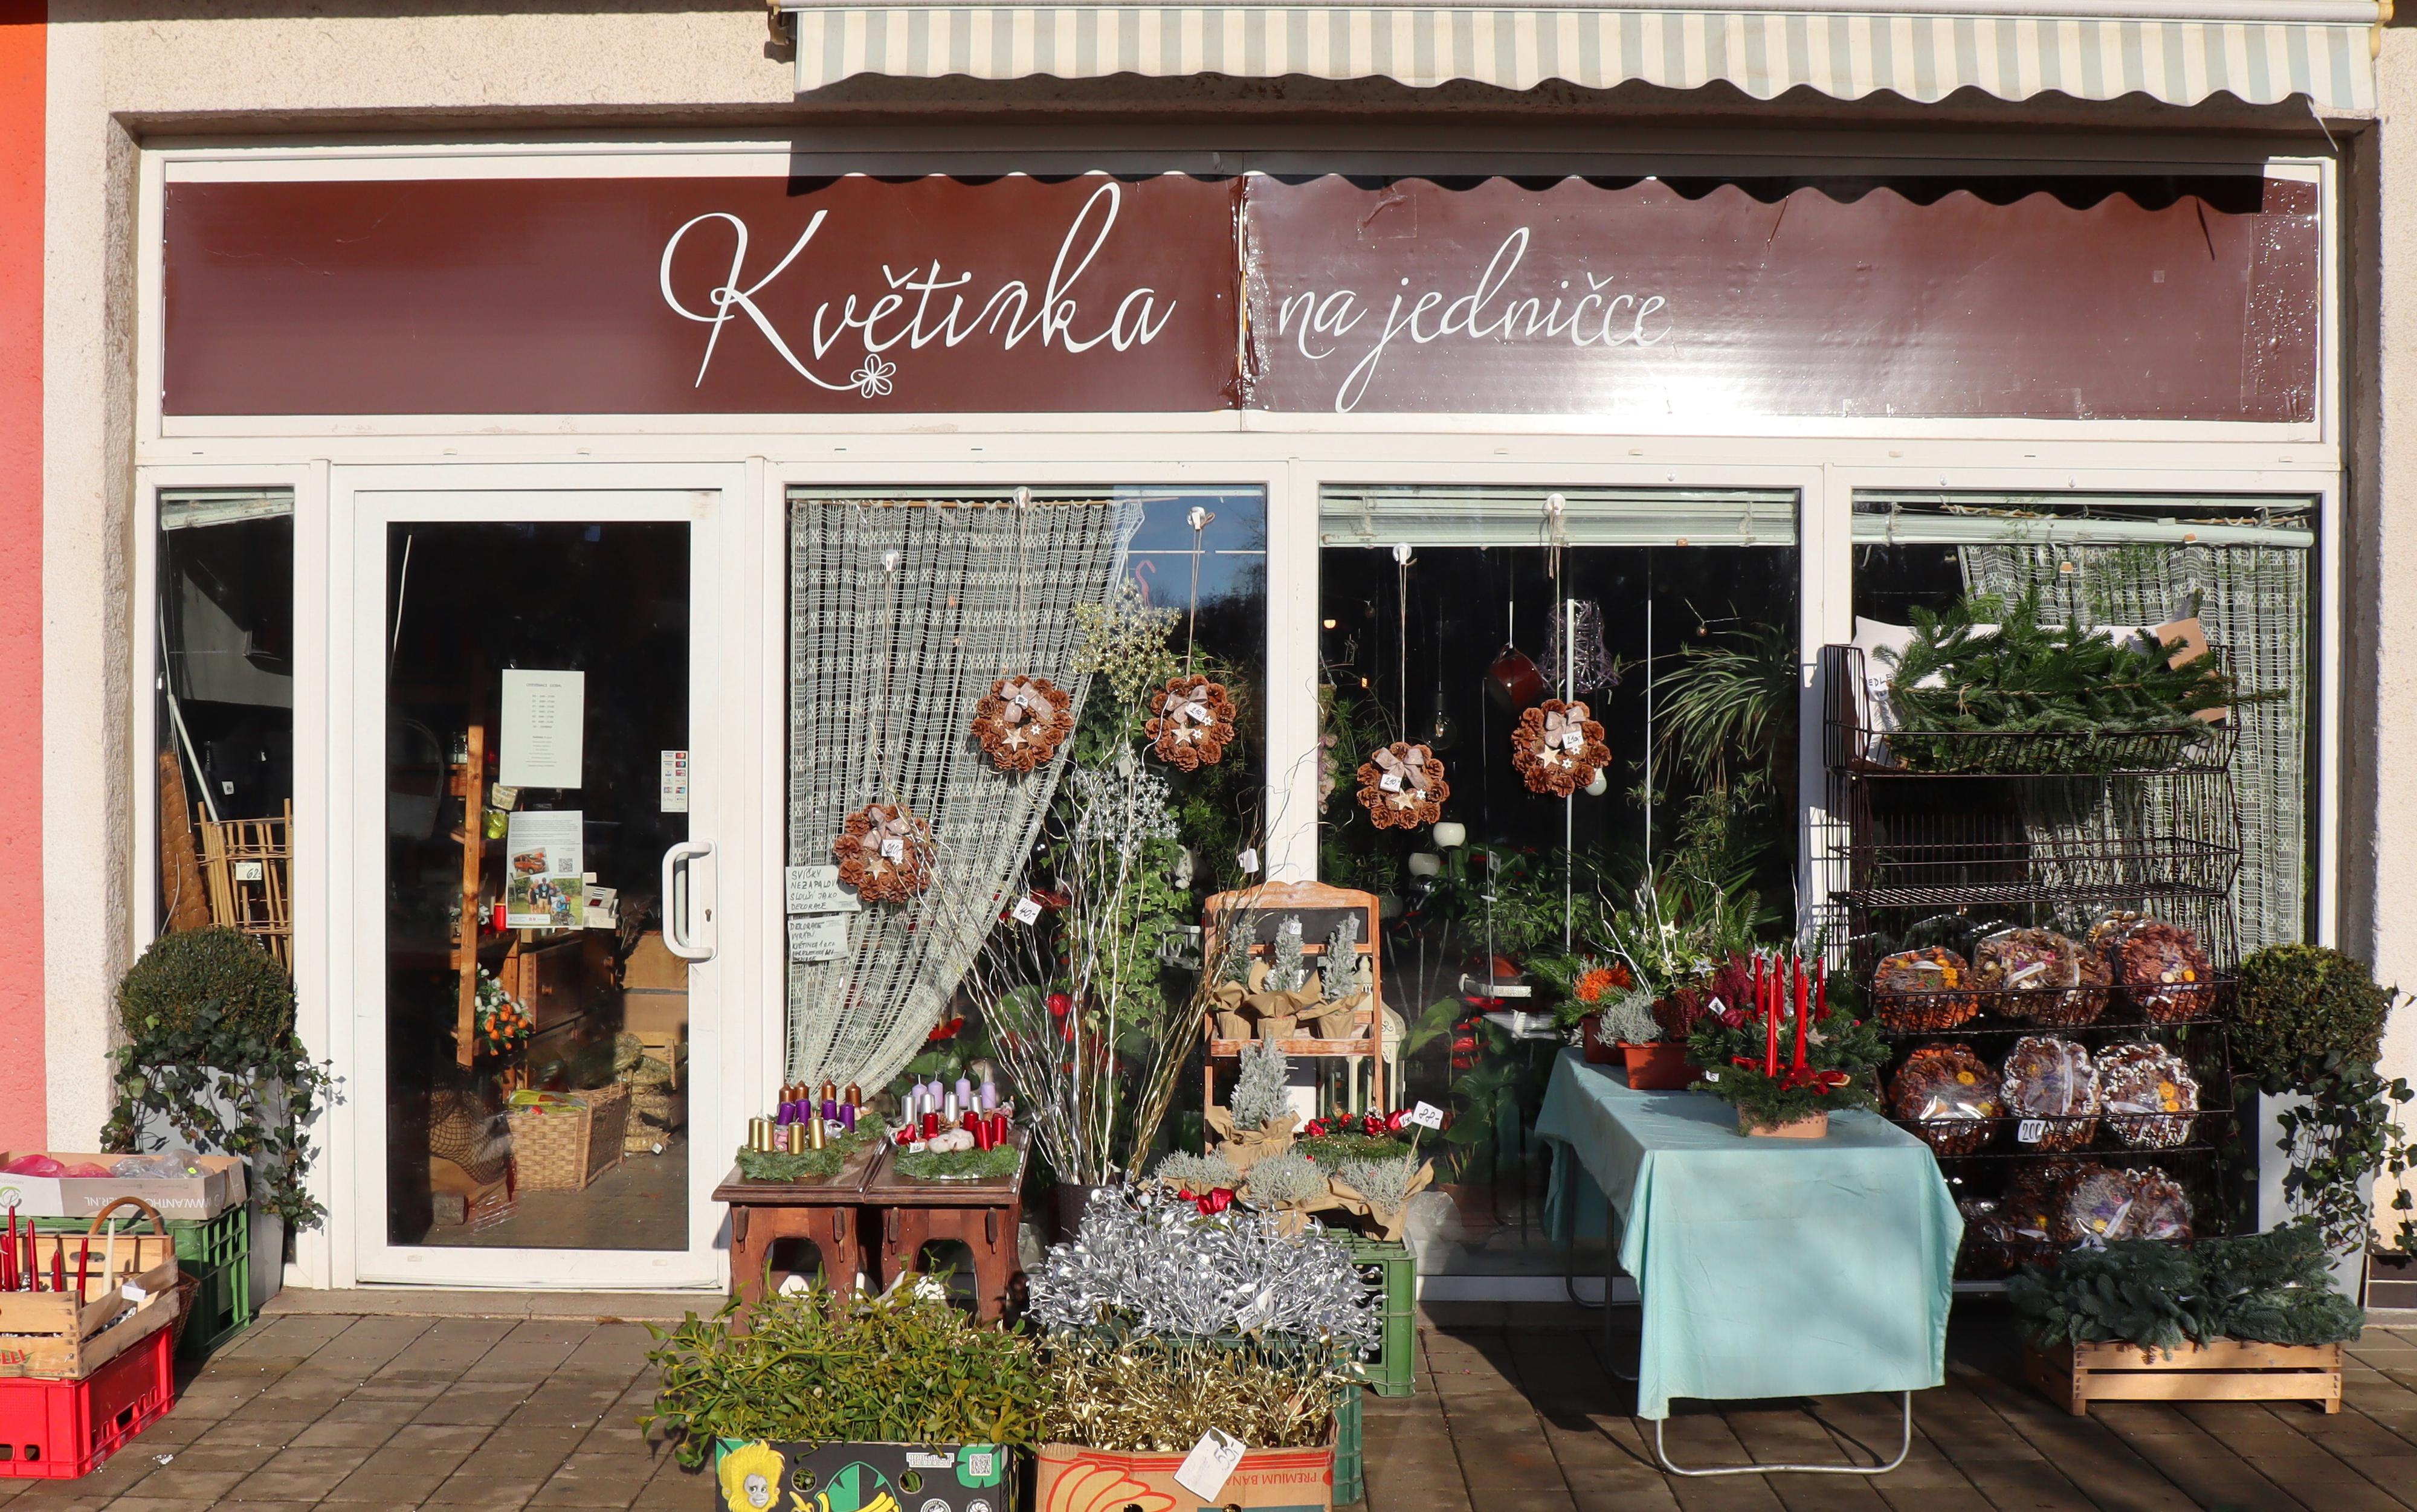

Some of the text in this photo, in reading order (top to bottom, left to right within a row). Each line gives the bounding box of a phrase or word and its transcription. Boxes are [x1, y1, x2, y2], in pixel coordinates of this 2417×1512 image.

[659, 181, 1672, 413] Květinka na jedničce
[1225, 1472, 1317, 1486] PREMIUM BANA
